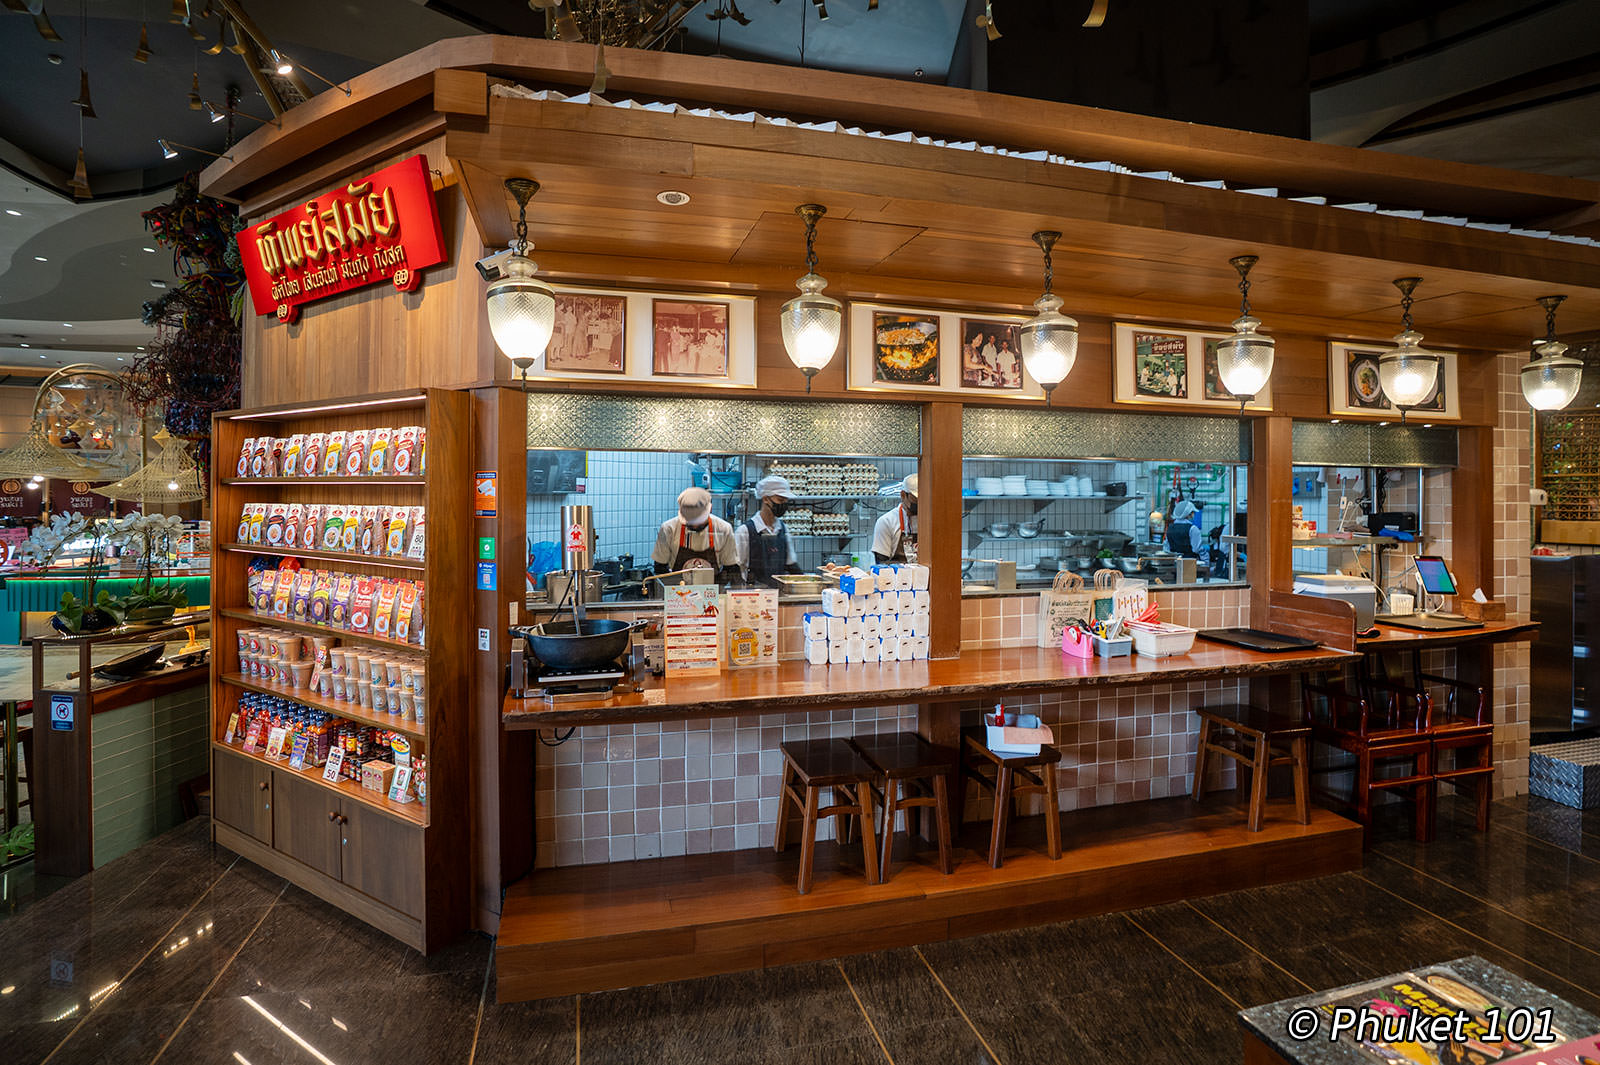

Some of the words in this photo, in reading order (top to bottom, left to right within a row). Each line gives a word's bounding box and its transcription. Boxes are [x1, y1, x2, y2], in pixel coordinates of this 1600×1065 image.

[256, 182, 397, 275] ทิพย์สมัย
[373, 245, 405, 276] กุ้งสด
[327, 769, 336, 779] 50
